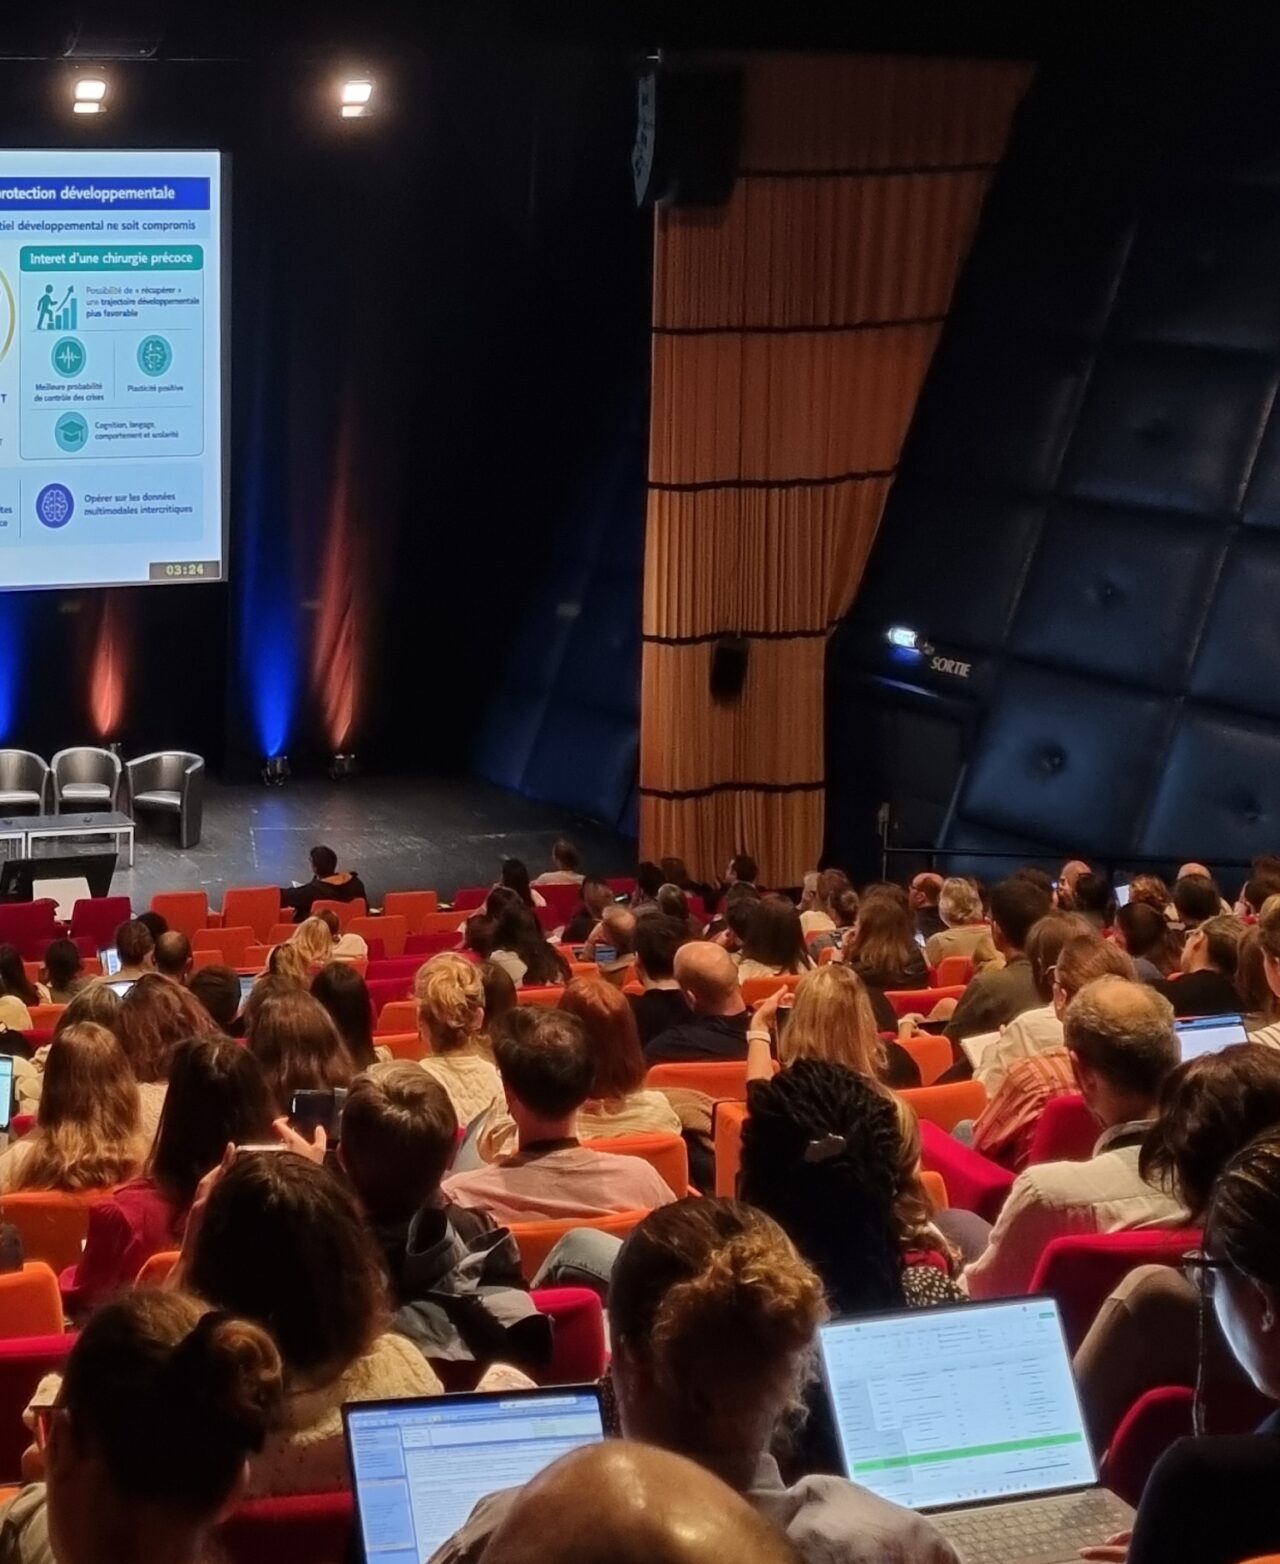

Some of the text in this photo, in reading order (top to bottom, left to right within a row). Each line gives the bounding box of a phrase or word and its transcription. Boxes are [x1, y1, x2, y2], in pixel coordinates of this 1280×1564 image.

[60, 185, 175, 202] développementale
[18, 220, 104, 233] développemental
[107, 222, 118, 230] ne
[122, 221, 139, 230] soit
[142, 220, 196, 233] compromis
[31, 251, 193, 266] Interet d'une chirurgie précoce
[84, 493, 112, 503] Opérer
[129, 493, 140, 501] les
[142, 492, 175, 501] données
[84, 505, 193, 516] multimodales intercritiques
[166, 564, 204, 576] 03:24
[931, 656, 971, 678] SORTIE
